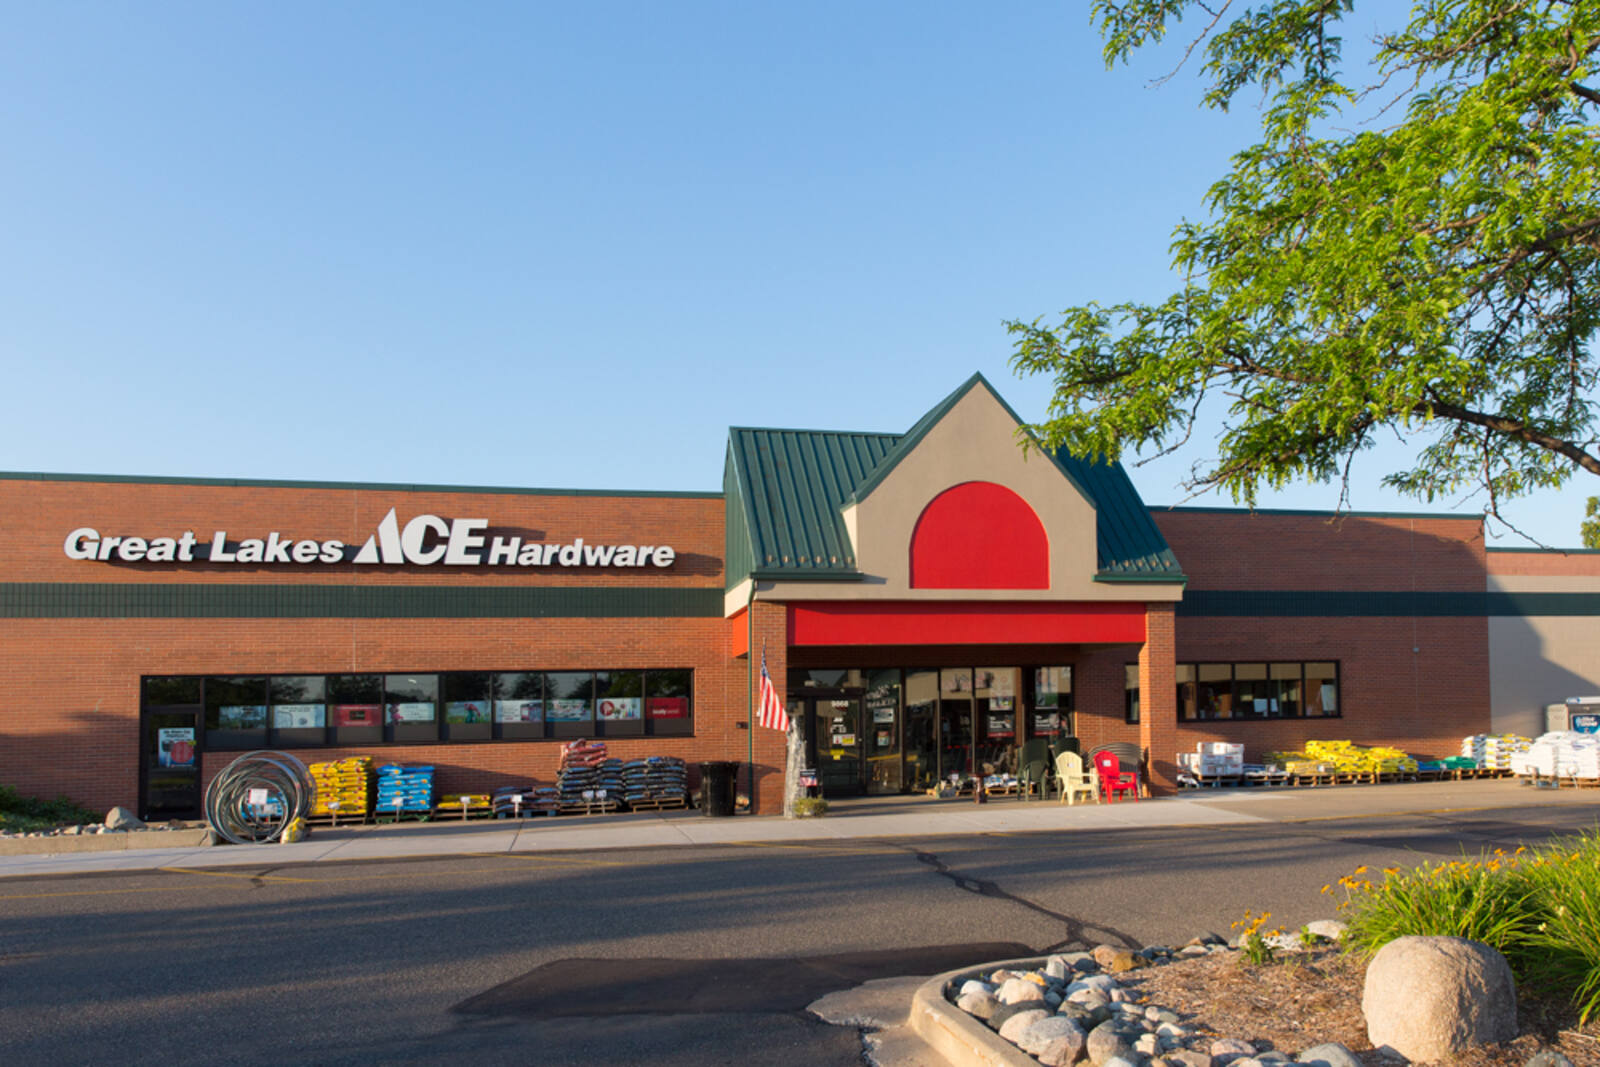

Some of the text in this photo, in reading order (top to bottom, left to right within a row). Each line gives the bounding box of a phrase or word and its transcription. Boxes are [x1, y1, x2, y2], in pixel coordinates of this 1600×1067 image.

[63, 507, 675, 569] Great Lakes ACE Hardware
